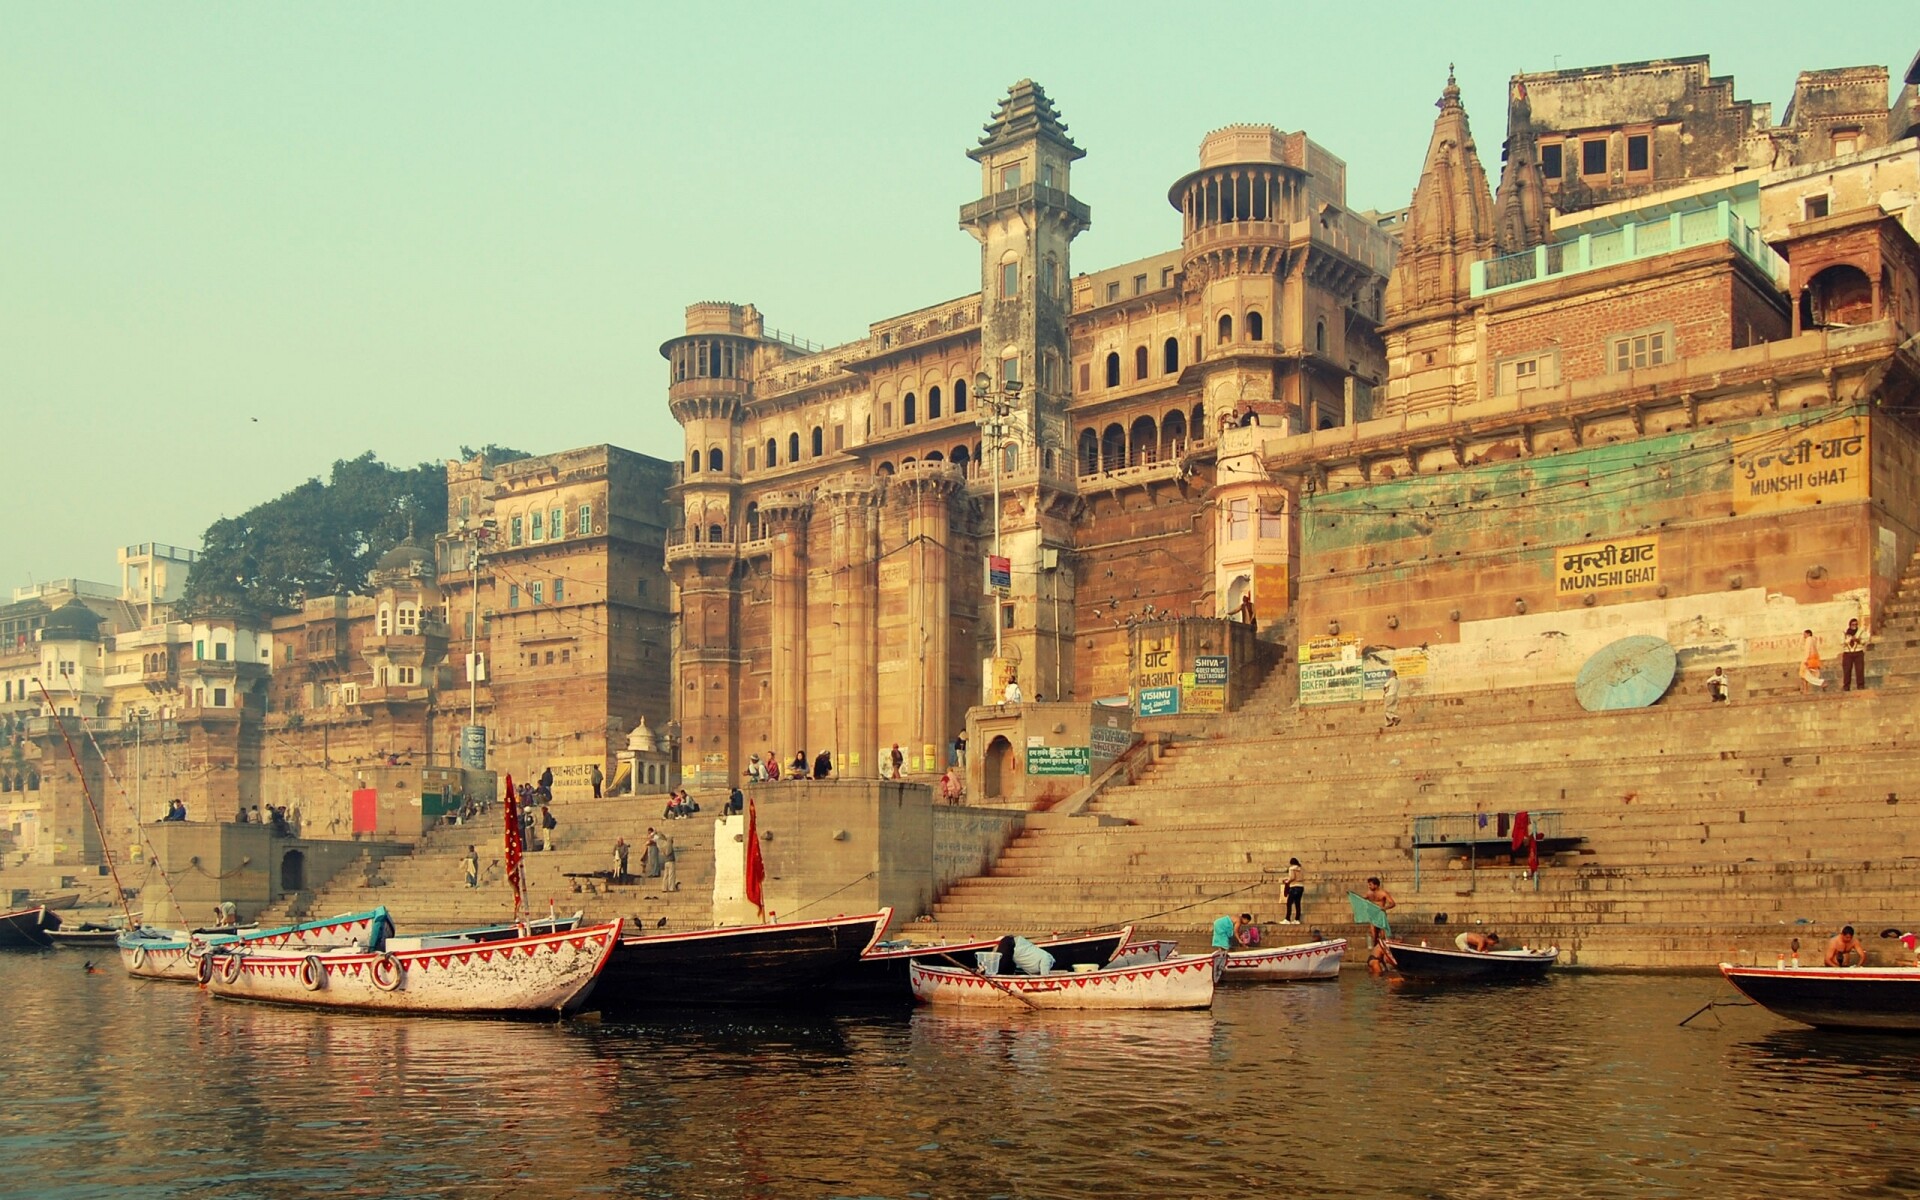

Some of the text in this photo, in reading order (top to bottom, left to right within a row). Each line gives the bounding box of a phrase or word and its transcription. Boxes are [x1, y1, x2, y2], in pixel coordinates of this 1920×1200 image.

[1820, 435, 1866, 459] घाट
[1750, 467, 1848, 497] MUNSHI GHAT
[1563, 543, 1656, 574] मुन्सी घाट
[1560, 566, 1657, 592] MUNSHI GHAT
[1195, 659, 1219, 667] SHIVA
[1366, 671, 1387, 679] YOGA
[1142, 691, 1171, 700] VISHNU
